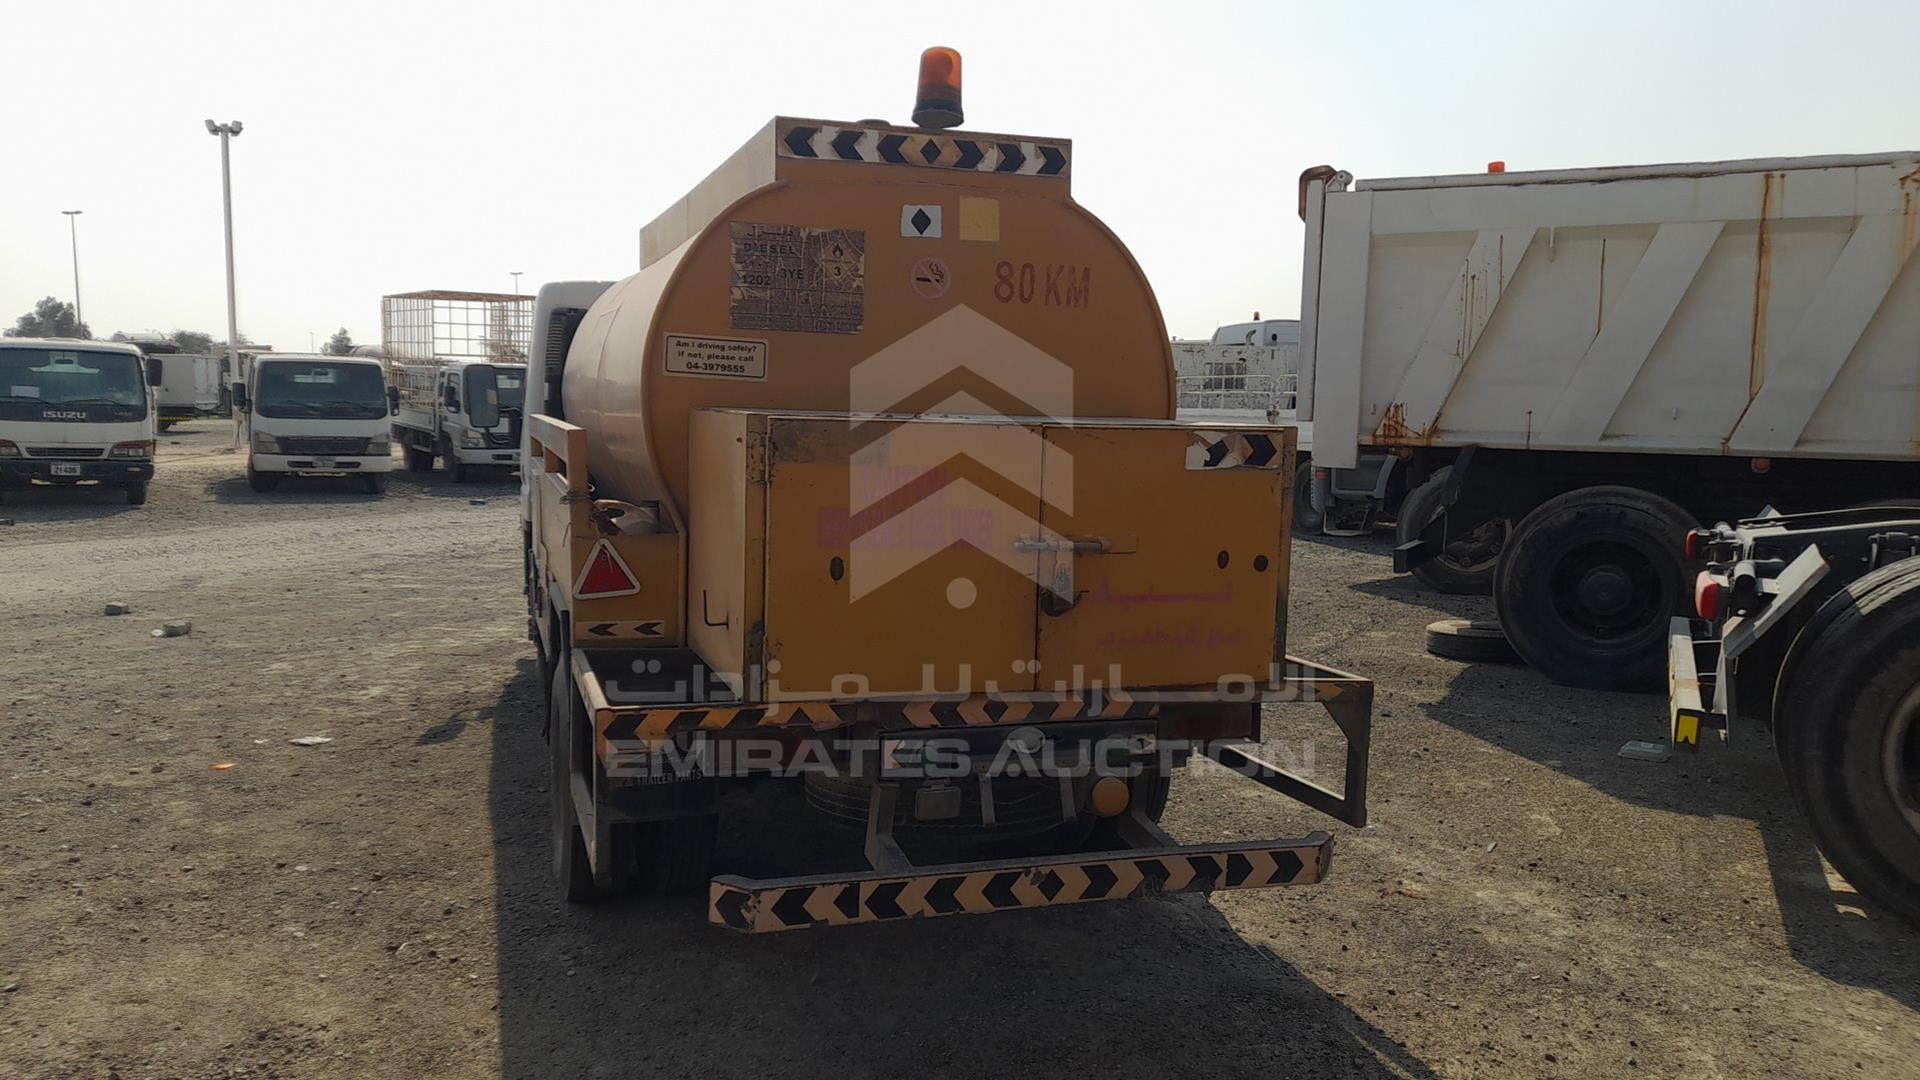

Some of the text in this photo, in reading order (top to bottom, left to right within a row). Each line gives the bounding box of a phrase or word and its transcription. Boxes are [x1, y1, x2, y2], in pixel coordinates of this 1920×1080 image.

[834, 267, 841, 277] 3
[993, 261, 1091, 308] 80 KM
[676, 340, 689, 348] Am
[697, 342, 726, 351] driving
[728, 343, 757, 353] safely?
[687, 351, 705, 359] not,
[707, 353, 736, 361] please
[686, 361, 745, 373] 04-3979555
[43, 411, 87, 419] ISUZU
